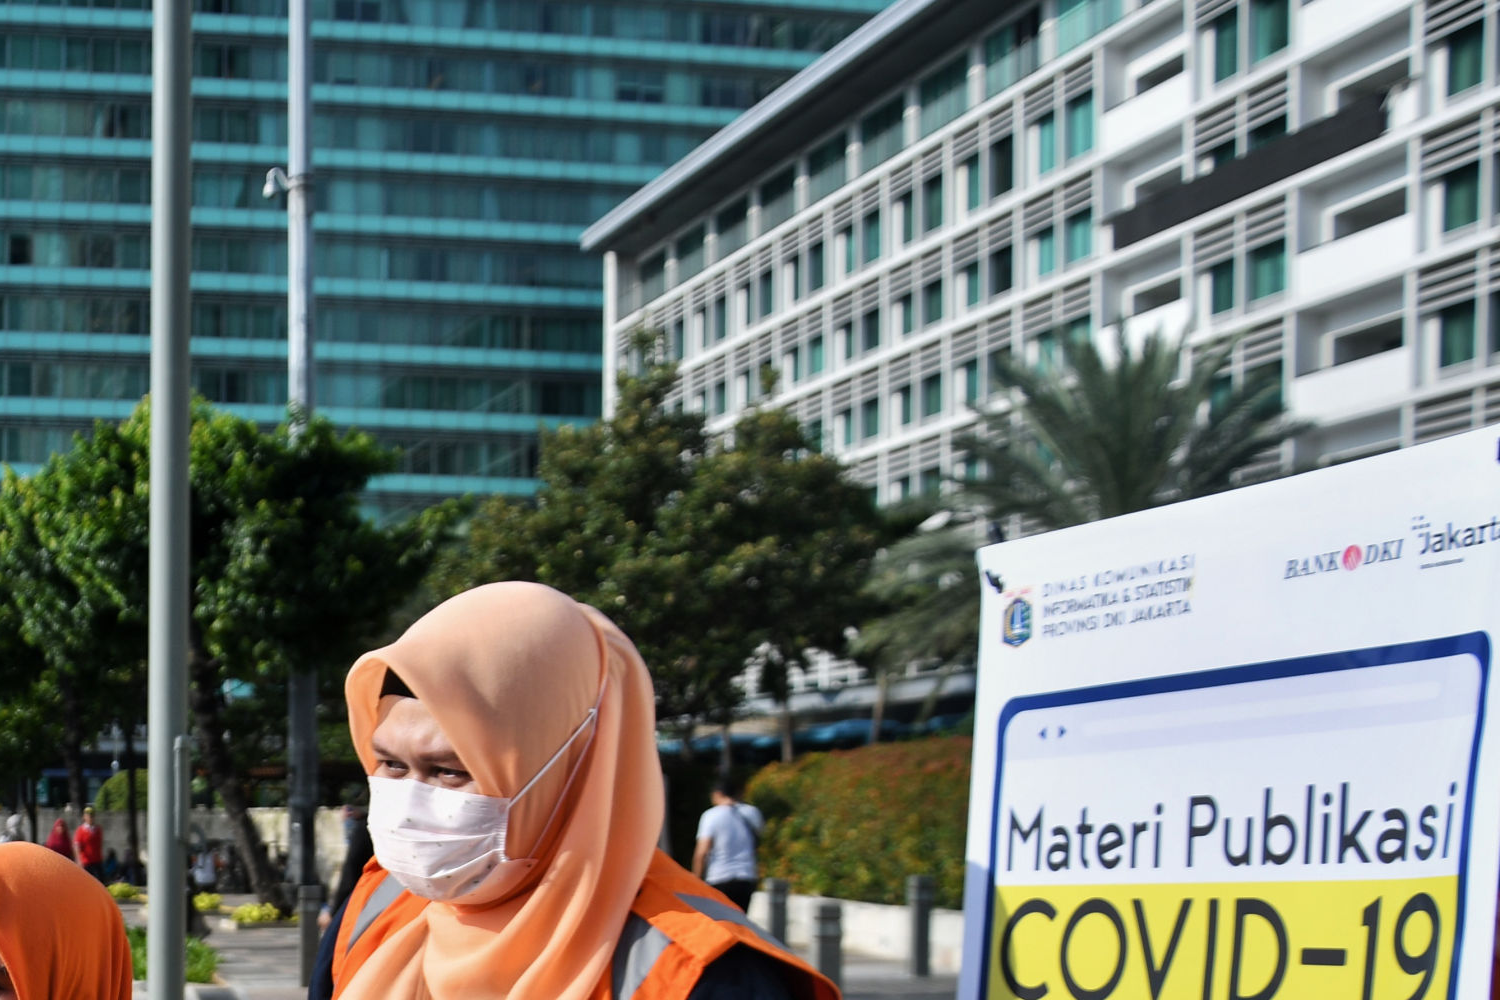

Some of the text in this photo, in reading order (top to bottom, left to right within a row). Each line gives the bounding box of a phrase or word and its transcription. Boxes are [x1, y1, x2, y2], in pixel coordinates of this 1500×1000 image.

[1417, 514, 1500, 555] Jakart
[1284, 538, 1404, 579] BANK DKI
[1128, 600, 1192, 624] JAKARTA
[1006, 781, 1458, 872] Materi Publikasi
